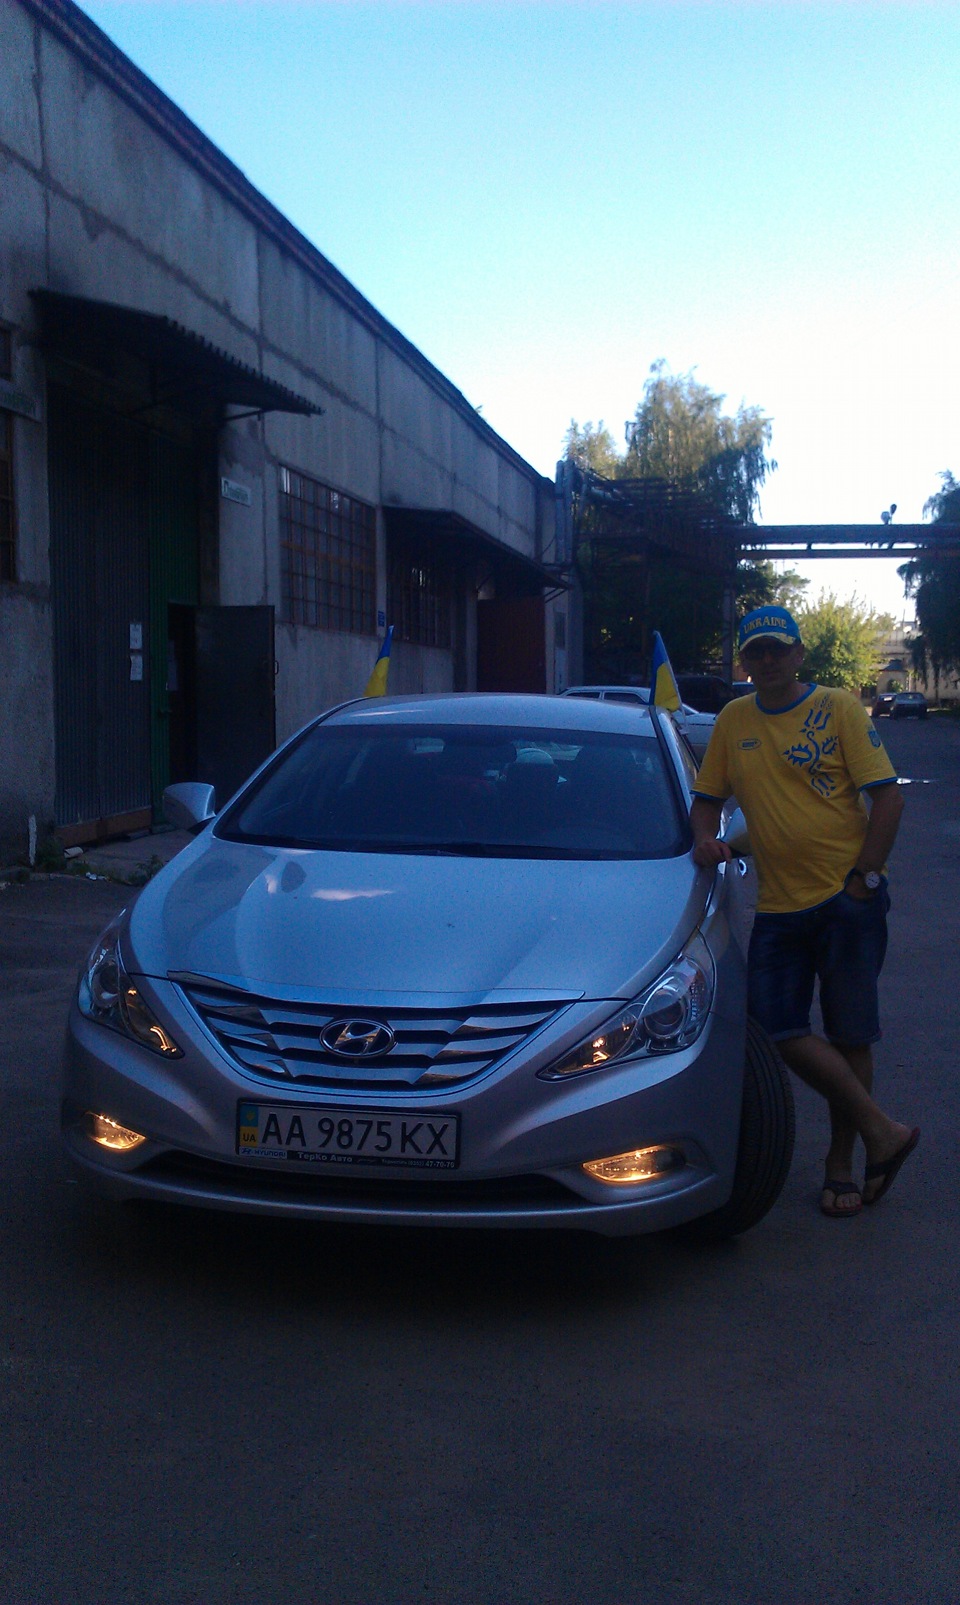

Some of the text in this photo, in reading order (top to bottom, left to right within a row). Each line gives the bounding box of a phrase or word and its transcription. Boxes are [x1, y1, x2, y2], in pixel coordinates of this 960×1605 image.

[743, 616, 787, 633] UKRAINE
[242, 1133, 256, 1142] UA
[317, 1117, 392, 1152] 9875
